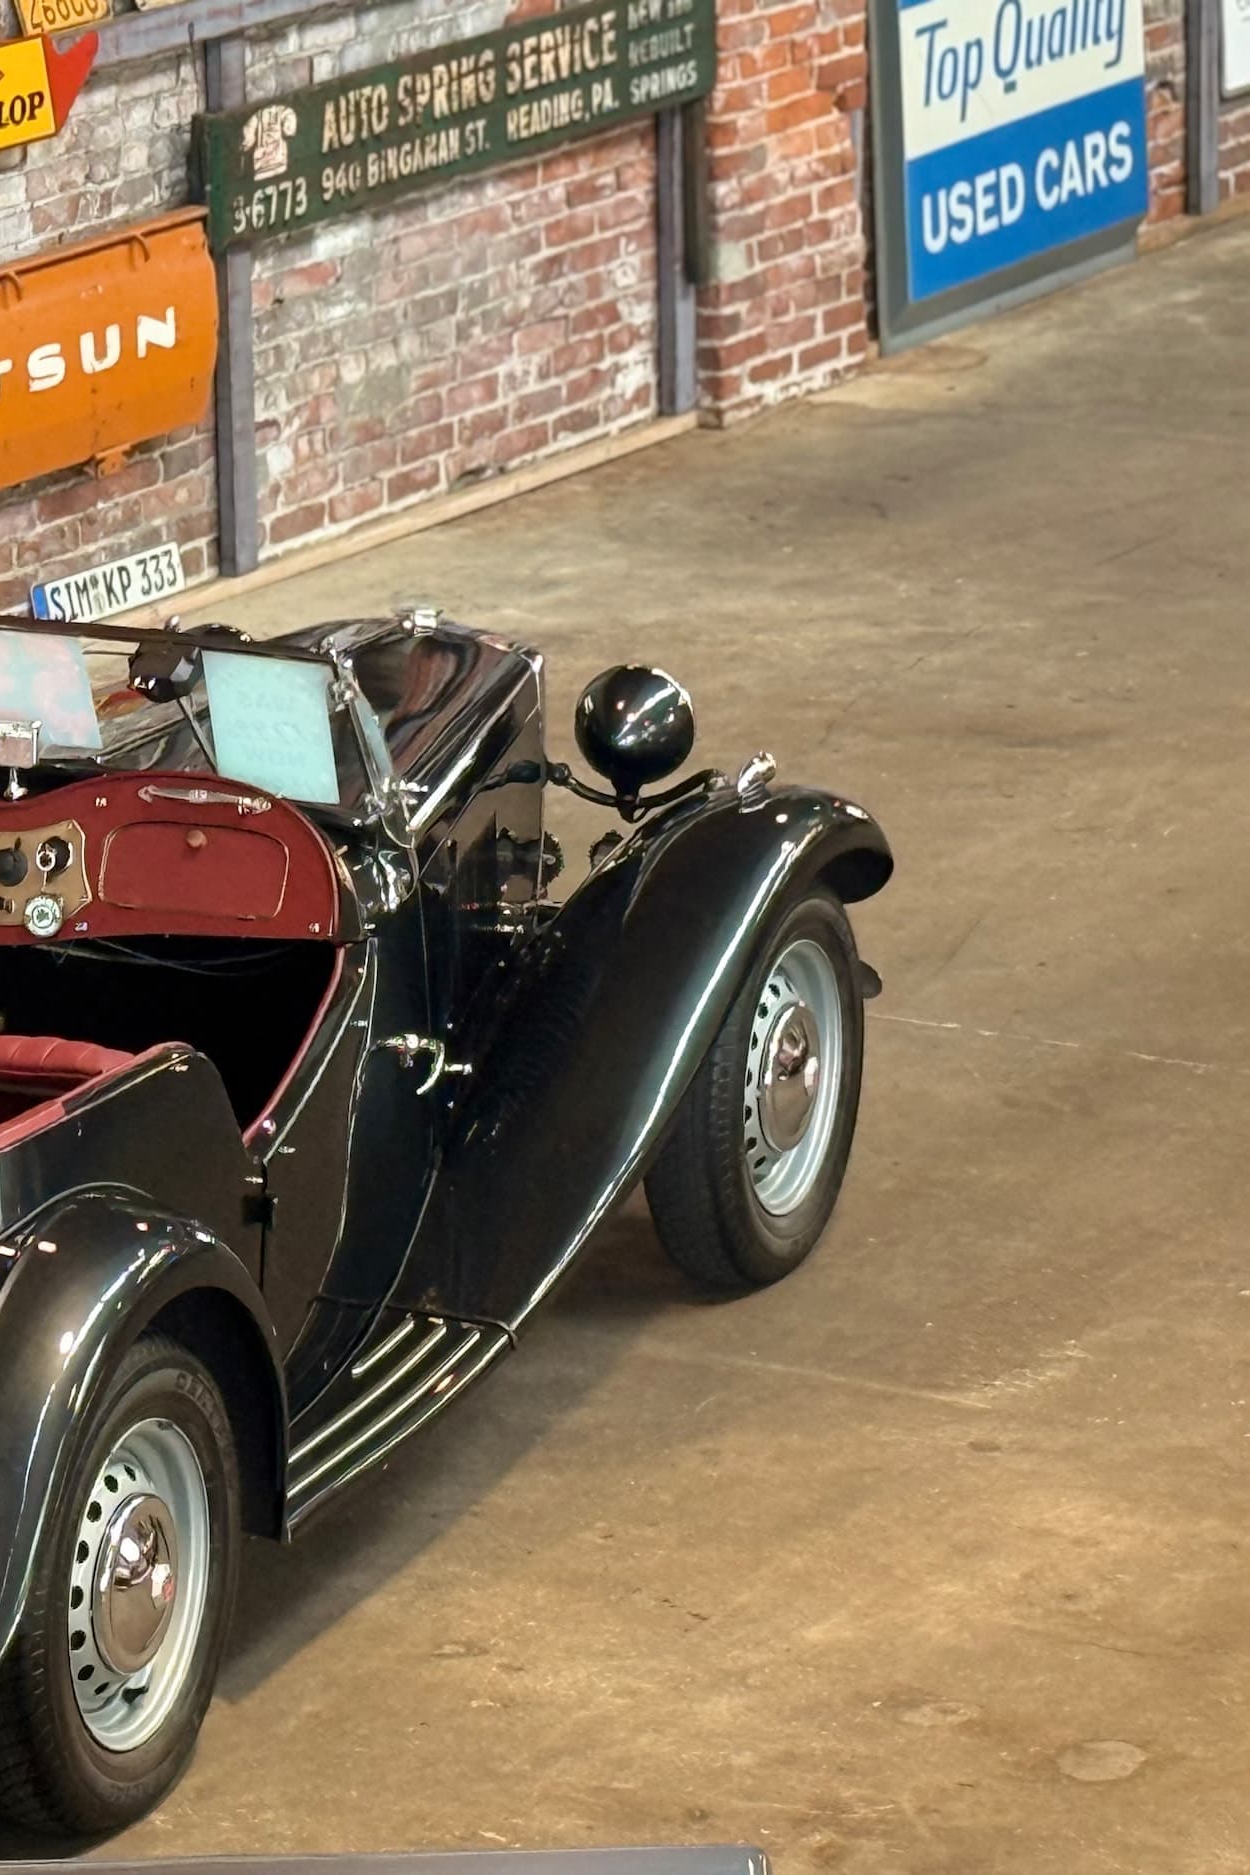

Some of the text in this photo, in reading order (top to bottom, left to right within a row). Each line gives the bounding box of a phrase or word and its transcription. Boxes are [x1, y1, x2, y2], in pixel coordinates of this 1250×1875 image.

[321, 10, 618, 153] AUTO SPRING SERVICE
[628, 23, 695, 68] REBUILT
[630, 59, 698, 105] SPRINGS
[915, 0, 1126, 123] Top Quality
[592, 77, 620, 113] PA.
[321, 166, 362, 201] 940
[465, 119, 491, 155] ST.
[922, 121, 1134, 254] USED CARS
[50, 549, 177, 622] SIM KP 333
